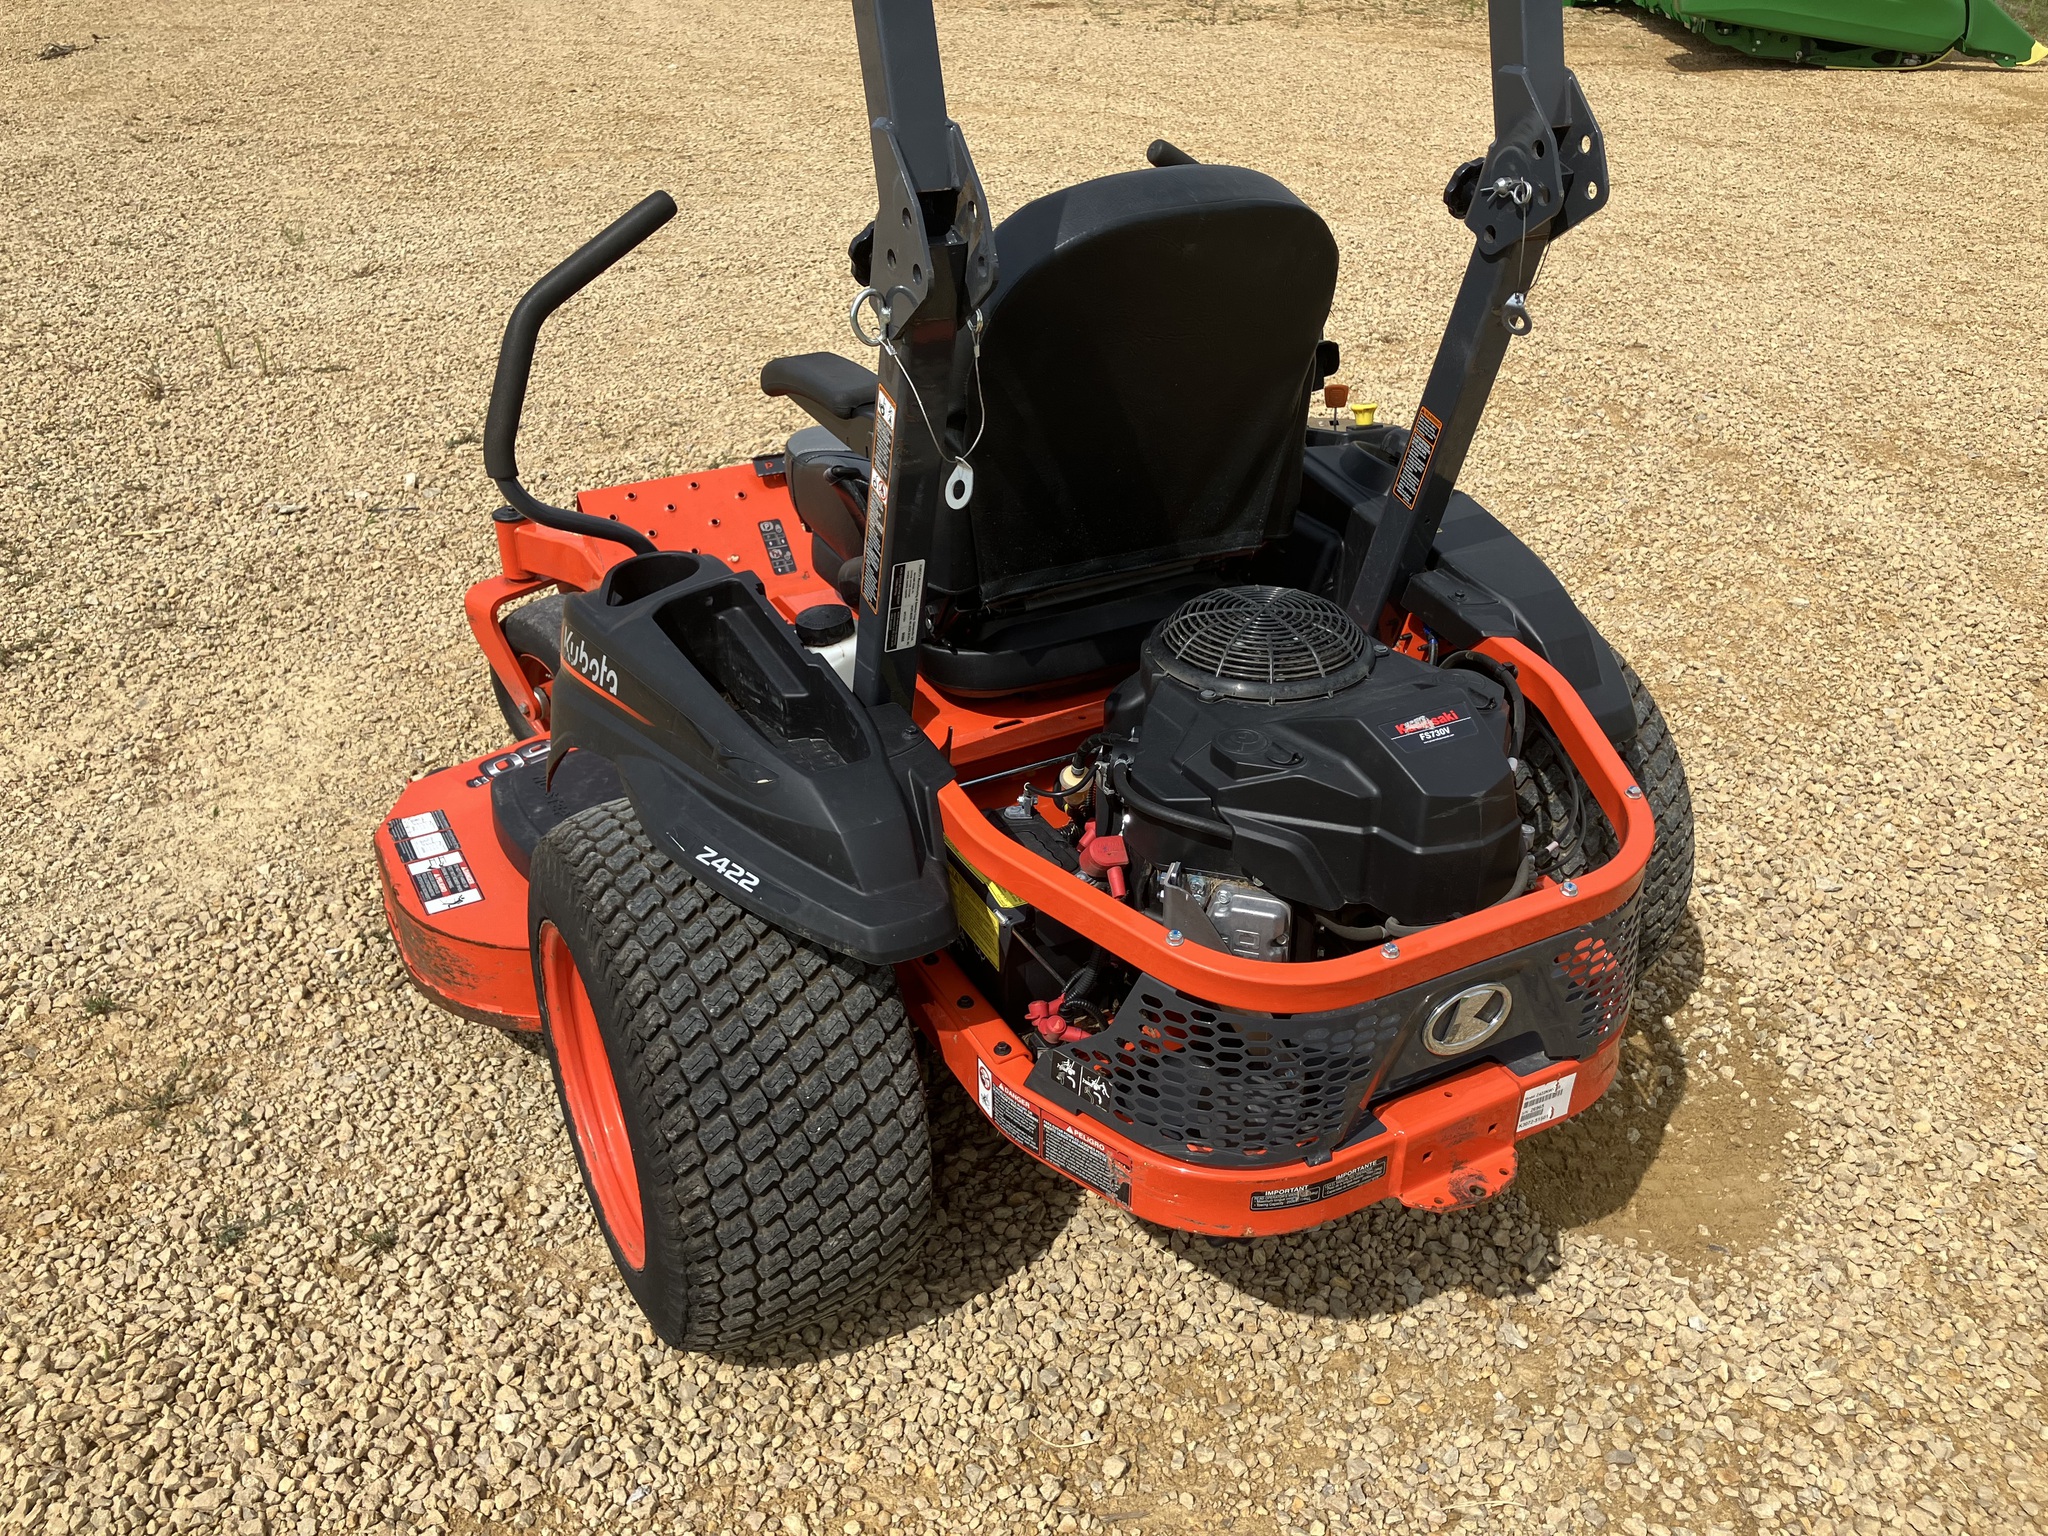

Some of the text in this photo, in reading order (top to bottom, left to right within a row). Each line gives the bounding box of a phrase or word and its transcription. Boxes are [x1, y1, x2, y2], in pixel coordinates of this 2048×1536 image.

[563, 625, 619, 696] Kubota
[1419, 726, 1451, 741] FS730V
[695, 845, 760, 894] Z422
[1004, 1087, 1030, 1109] DANGER
[1073, 1129, 1105, 1151] PELIGRO
[1335, 1160, 1377, 1181] IMPORTANTE
[1265, 1184, 1309, 1196] IMPORTANT
